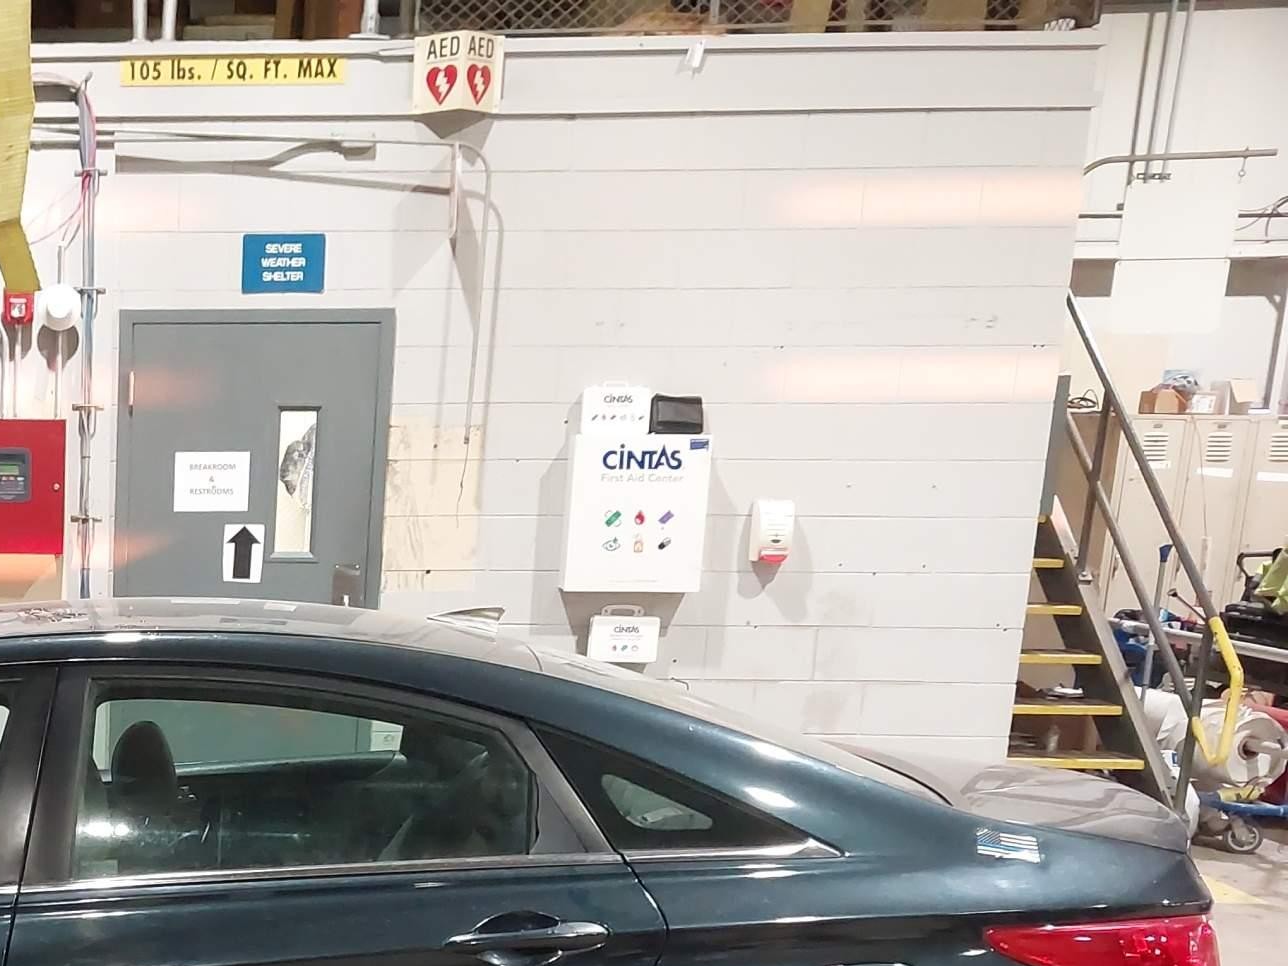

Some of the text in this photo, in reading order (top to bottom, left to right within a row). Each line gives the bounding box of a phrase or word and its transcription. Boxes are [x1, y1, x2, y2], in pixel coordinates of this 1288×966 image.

[426, 36, 460, 60] AED
[468, 35, 495, 59] AED
[129, 58, 338, 81] 105 lbs. / SQ. FT. MAX
[264, 243, 302, 254] SEVERE
[260, 257, 307, 268] WEATHER
[262, 271, 304, 282] SHELTER
[189, 463, 237, 471] BREAKROOM
[600, 473, 684, 482] First Aid Center
[189, 487, 234, 496] RESTROOMS
